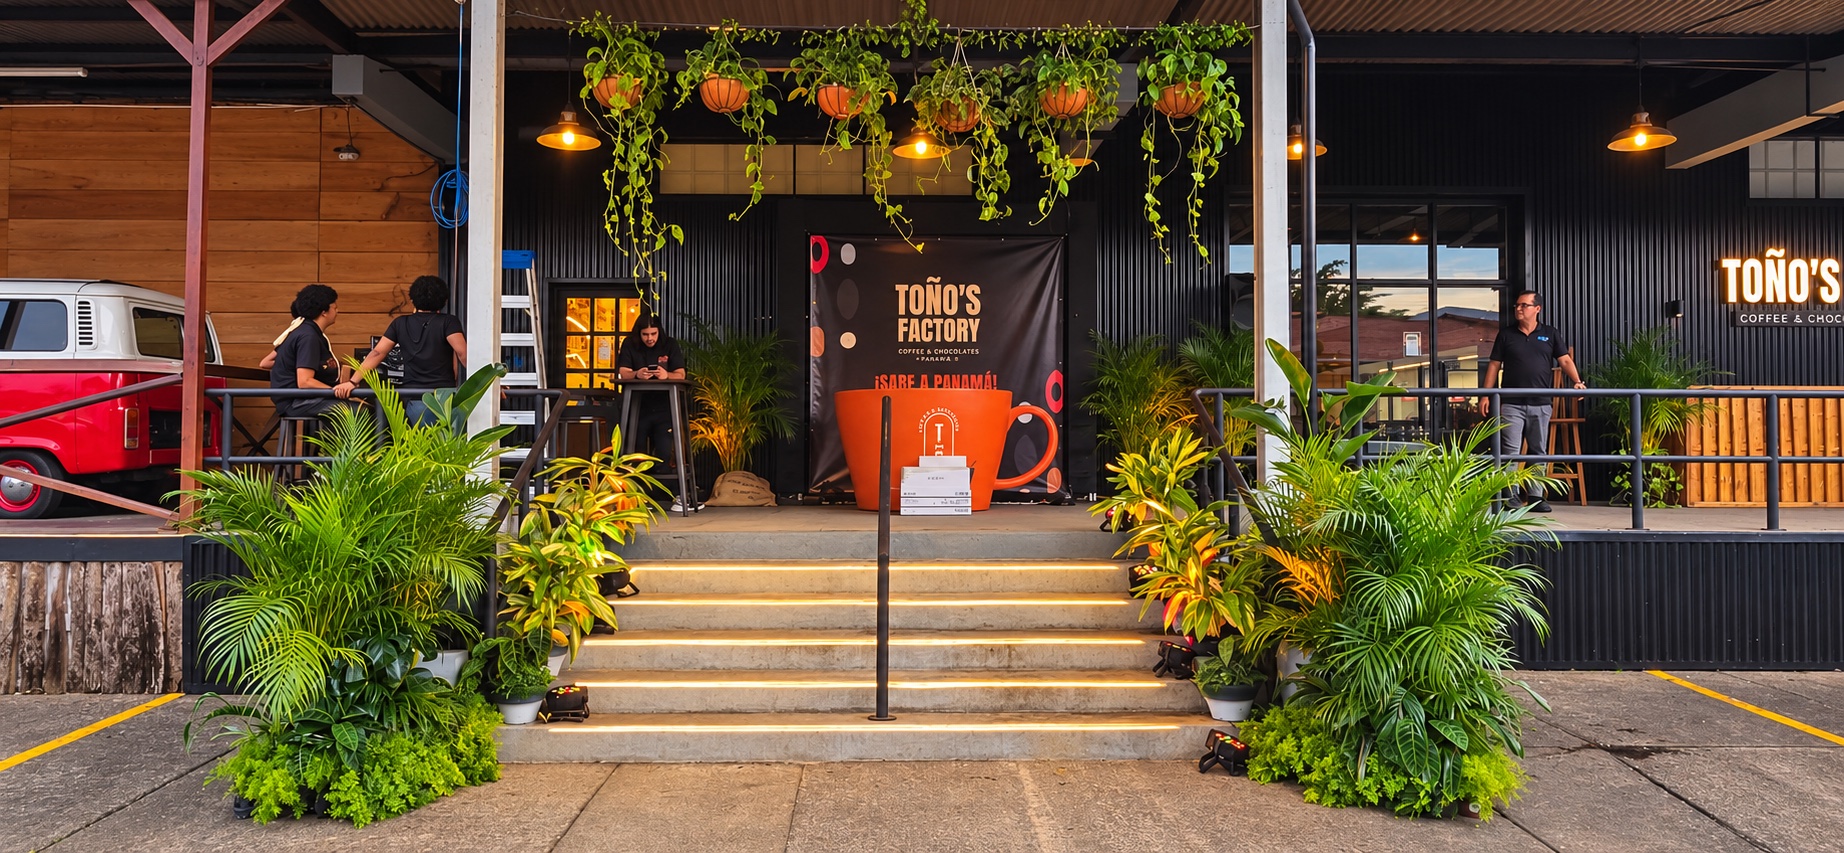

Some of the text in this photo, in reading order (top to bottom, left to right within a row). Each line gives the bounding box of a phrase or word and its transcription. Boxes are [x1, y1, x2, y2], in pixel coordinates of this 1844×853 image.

[1721, 247, 1841, 304] TOÑO'S
[895, 276, 981, 316] TOÑO'S
[897, 318, 981, 343] FACTORY
[1740, 313, 1844, 324] COFFEE & CHOC
[920, 374, 929, 389] A
